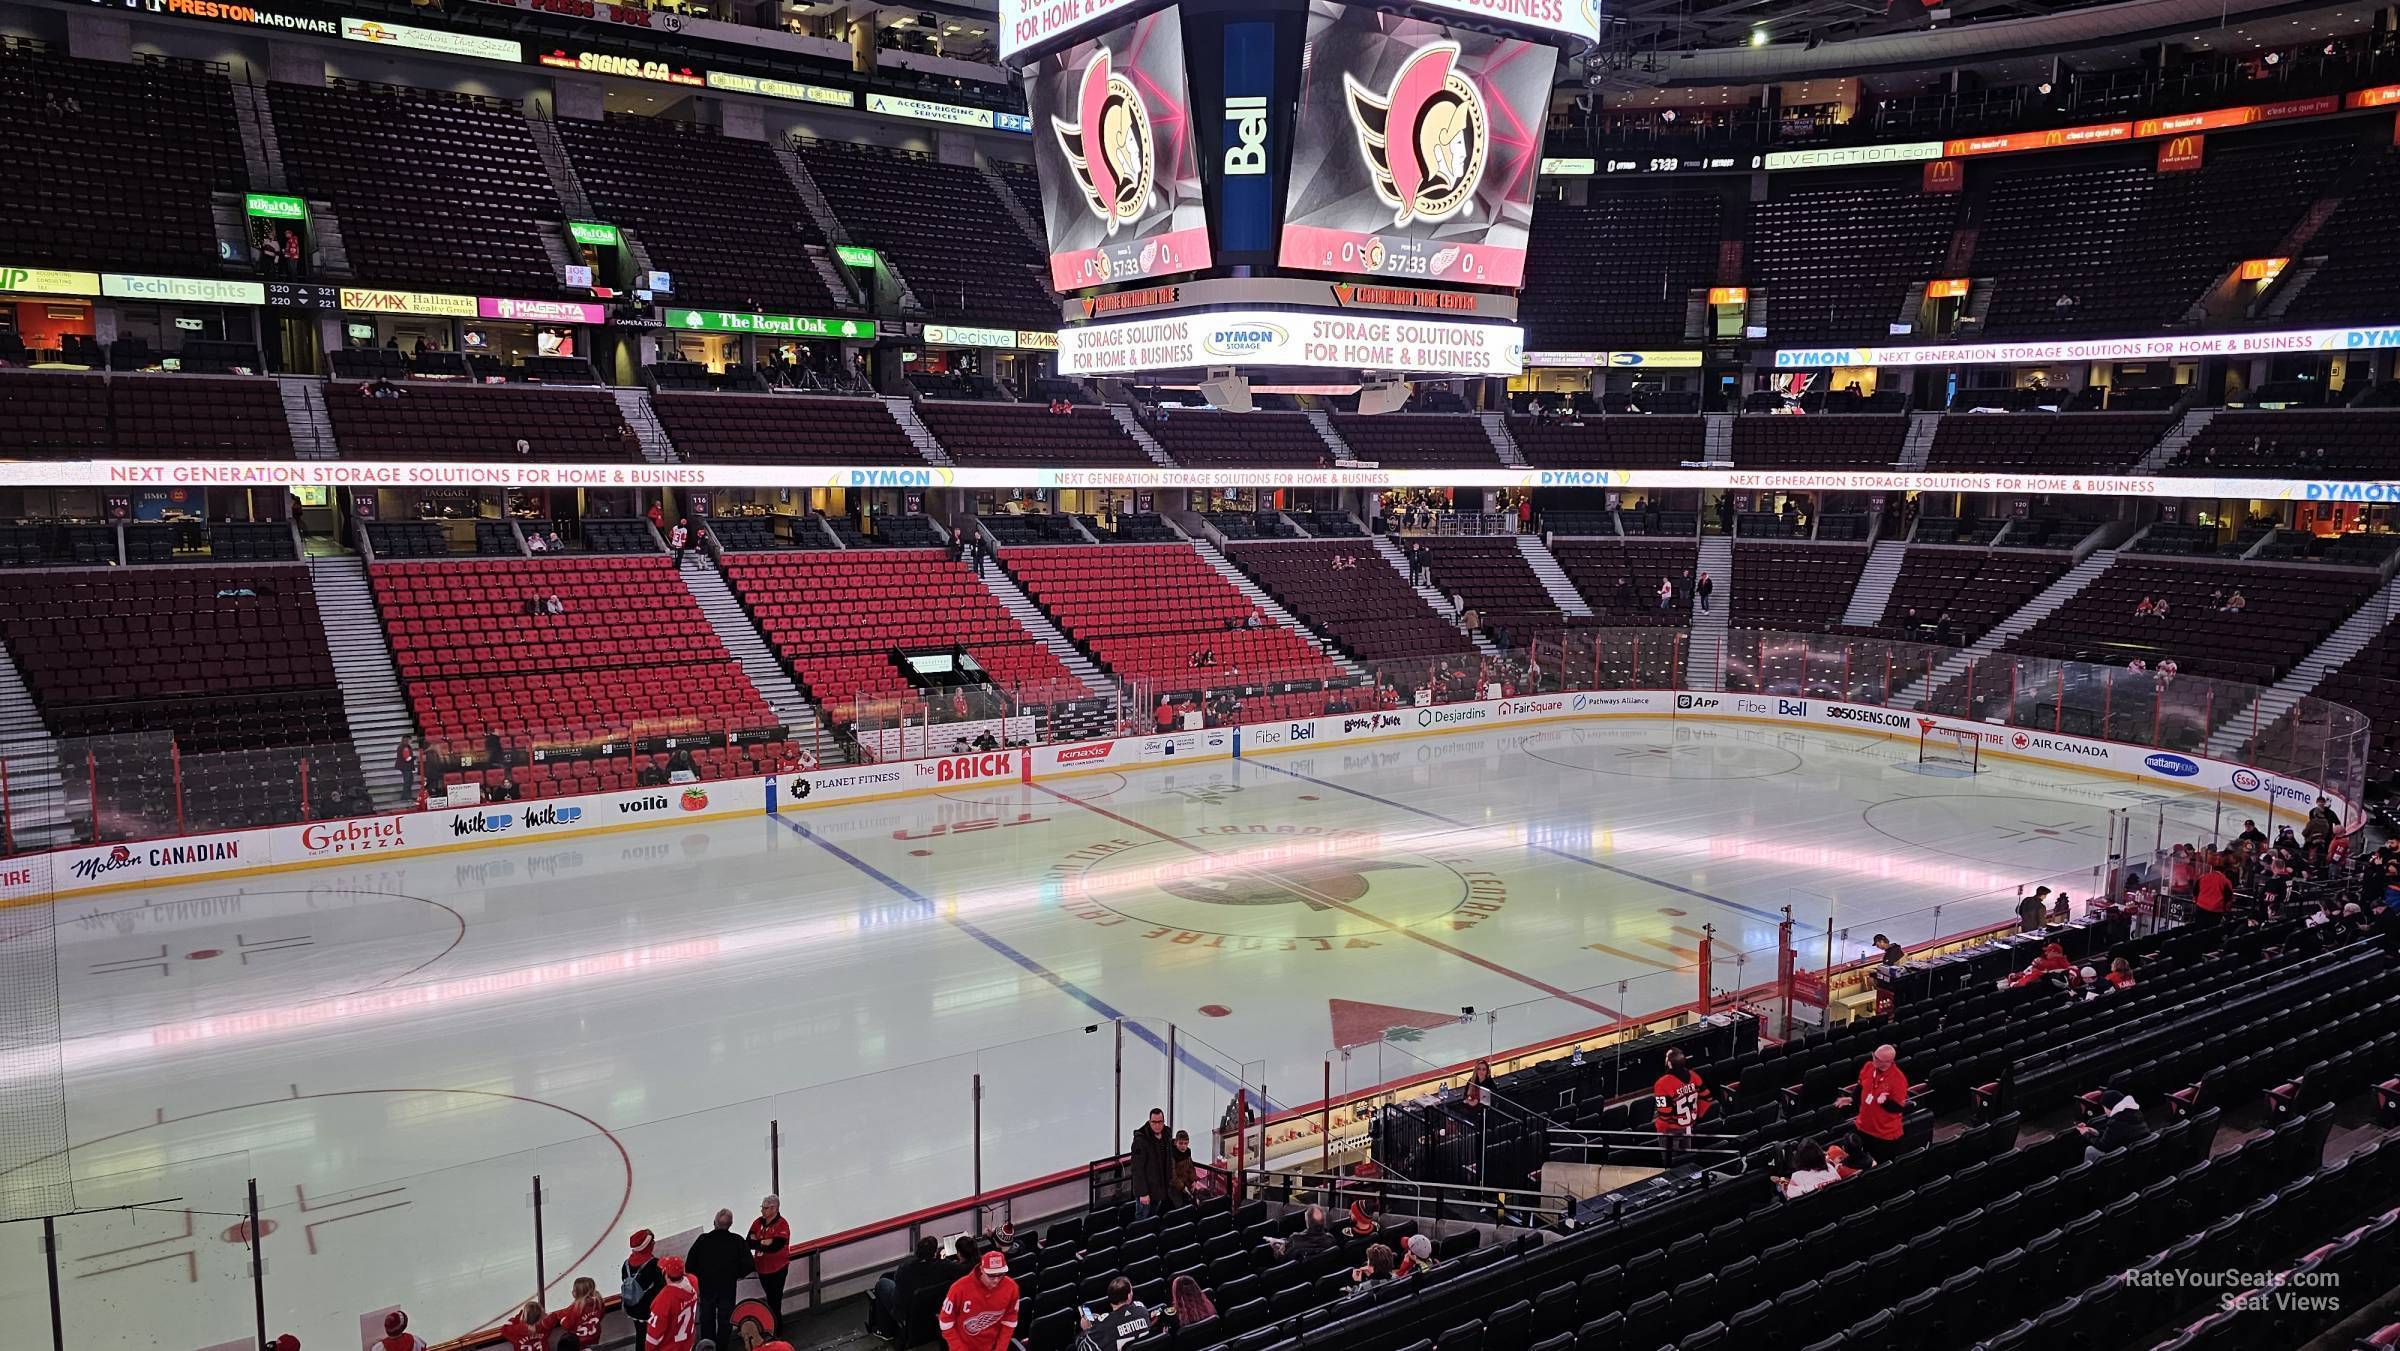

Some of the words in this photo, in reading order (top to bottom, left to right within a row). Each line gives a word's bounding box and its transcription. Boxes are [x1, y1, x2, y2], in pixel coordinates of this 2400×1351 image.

[668, 17, 679, 28] 18
[1016, 15, 1039, 45] FOR
[1043, 0, 1079, 33] HOME
[403, 29, 447, 45] Kitchens
[450, 35, 475, 48] That
[580, 52, 671, 81] SIGNS.CA
[897, 100, 932, 110] ACCESS
[935, 105, 974, 116] RIGGING
[914, 110, 958, 121] SERVICES
[1224, 96, 1267, 175] Bell
[1769, 146, 1938, 167] LIVENATION.com
[1084, 258, 1093, 277] 0
[1113, 257, 1139, 277] 57:33
[1162, 244, 1170, 264] 0
[1342, 241, 1354, 262] 0
[1388, 254, 1427, 274] 57:33
[1462, 253, 1473, 273] 0
[121, 277, 246, 299] TechInsights
[270, 285, 289, 293] 320
[318, 287, 335, 296] 321
[272, 297, 290, 305] 220
[320, 300, 336, 308] 221
[344, 291, 407, 311] RE/MAX
[413, 294, 474, 307] Hallmark
[516, 300, 584, 316] MAGENTA
[413, 304, 445, 313] Realty
[446, 306, 475, 316] Group
[616, 319, 642, 327] CAMERA
[643, 320, 663, 328] STAND
[719, 312, 750, 328] The
[752, 314, 795, 333] Royal
[797, 317, 828, 333] Oak
[946, 328, 1010, 347] Decisive
[1020, 332, 1058, 348] RE/MAX
[1078, 328, 1123, 349] STORAGE
[1127, 322, 1188, 345] SOLUTIONS
[1215, 331, 1273, 344] DYMON
[1313, 321, 1390, 342] STORAGE
[1397, 325, 1485, 347] SOLUTIONS
[1073, 352, 1092, 369] FOR
[1096, 349, 1126, 367] HOME
[1129, 349, 1137, 365] &
[1141, 344, 1193, 364] BUSINESS
[1304, 343, 1338, 363] FOR
[1344, 345, 1393, 365] HOME
[1400, 348, 1411, 365] &
[1418, 349, 1490, 369] BUSINESS
[1778, 350, 1849, 366] DYMON
[1878, 351, 1911, 363] NEXT
[1915, 348, 1996, 362] GENERATION
[2001, 346, 2063, 359] STORAGE
[2067, 341, 2141, 357] SOLUTIONS
[2147, 342, 2173, 353] FOR
[2180, 340, 2221, 352] HOME
[2228, 340, 2237, 350] &
[2244, 336, 2312, 350] BUSINESS
[110, 466, 165, 482] NEXT
[173, 466, 305, 482] GENERATION
[314, 466, 401, 482] STORAGE
[409, 467, 510, 482] SOLUTIONS
[517, 468, 550, 482] FOR
[557, 469, 606, 483] HOME
[613, 469, 625, 483] &
[631, 469, 705, 484] BUSINESS
[851, 470, 930, 486] DYMON
[1055, 472, 1084, 484] NEXT
[1088, 472, 1159, 485] GENERATION
[1163, 473, 1211, 484] STORAGE
[1214, 473, 1272, 484] SOLUTIONS
[1274, 473, 1294, 484] FOR
[1297, 473, 1328, 484] HOME
[1331, 473, 1339, 484] &
[1342, 473, 1389, 484] BUSINESS
[1541, 472, 1608, 485] DYMON
[1730, 474, 1761, 486] NEXT
[1765, 475, 1846, 486] GENERATION
[1851, 476, 1911, 488] STORAGE
[1915, 477, 1990, 489] SOLUTIONS
[1996, 478, 2021, 489] FOR
[2028, 479, 2067, 490] HOME
[2073, 480, 2082, 491] &
[2087, 480, 2154, 492] BUSINESS
[144, 492, 167, 500] BMO
[424, 488, 469, 497] TAGGART
[1513, 701, 1562, 714] FairSquare
[1589, 698, 1620, 706] Pathways
[1737, 699, 1766, 713] Fibe
[1778, 699, 1807, 717] Bell
[1435, 707, 1485, 724] Desjardins
[1826, 706, 1911, 729] 5050SENS.COM
[1255, 730, 1280, 744] Fibe
[1291, 722, 1315, 741] Bell
[1344, 718, 1371, 733] Booster
[1984, 732, 2004, 745] TIRE
[2032, 738, 2051, 750] AIR
[2054, 741, 2109, 758] CANADA
[914, 763, 935, 777] The
[937, 753, 1011, 782] BRICK
[816, 778, 855, 790] PLANET
[858, 772, 900, 785] FITNESS
[2264, 779, 2311, 805] Supreme
[302, 815, 404, 850] Gabriel
[335, 837, 405, 853] PIZZA
[70, 855, 142, 881] Molson
[149, 841, 238, 867] CANADIAN
[1676, 1092, 1699, 1126] 53
[962, 1300, 972, 1313] C
